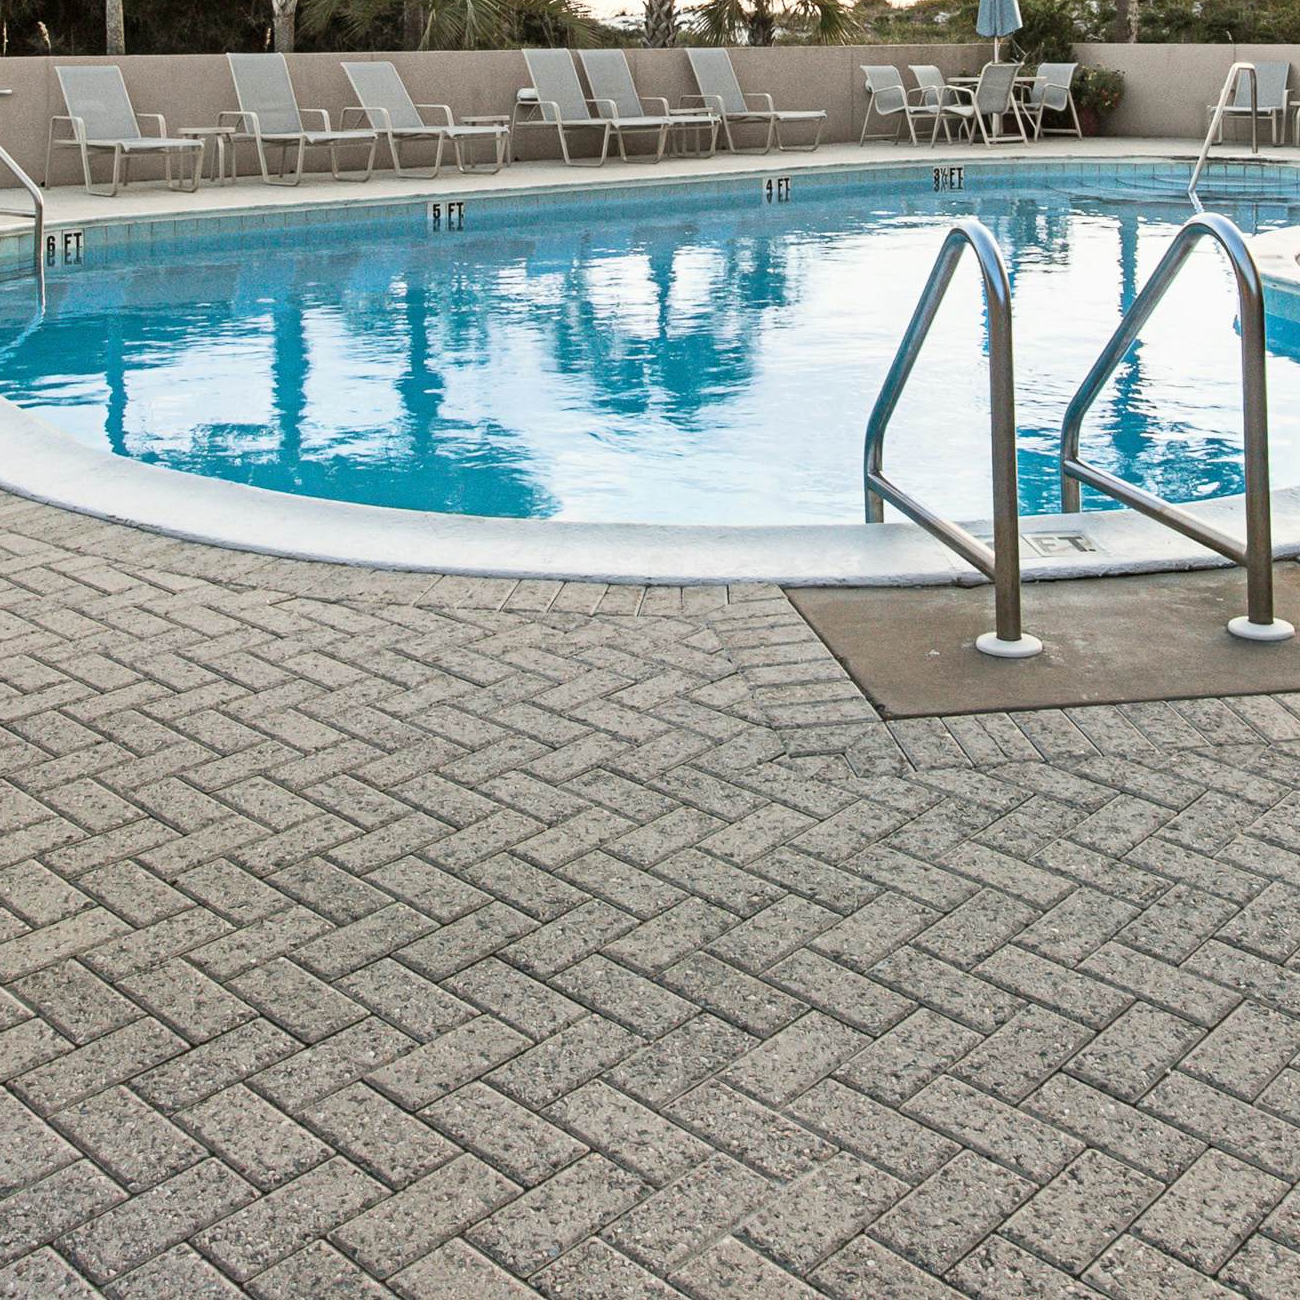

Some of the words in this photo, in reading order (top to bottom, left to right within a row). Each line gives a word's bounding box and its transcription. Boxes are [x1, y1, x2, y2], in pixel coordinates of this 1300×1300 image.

[766, 179, 773, 192] 4
[432, 203, 441, 219] 5
[46, 235, 56, 251] 6
